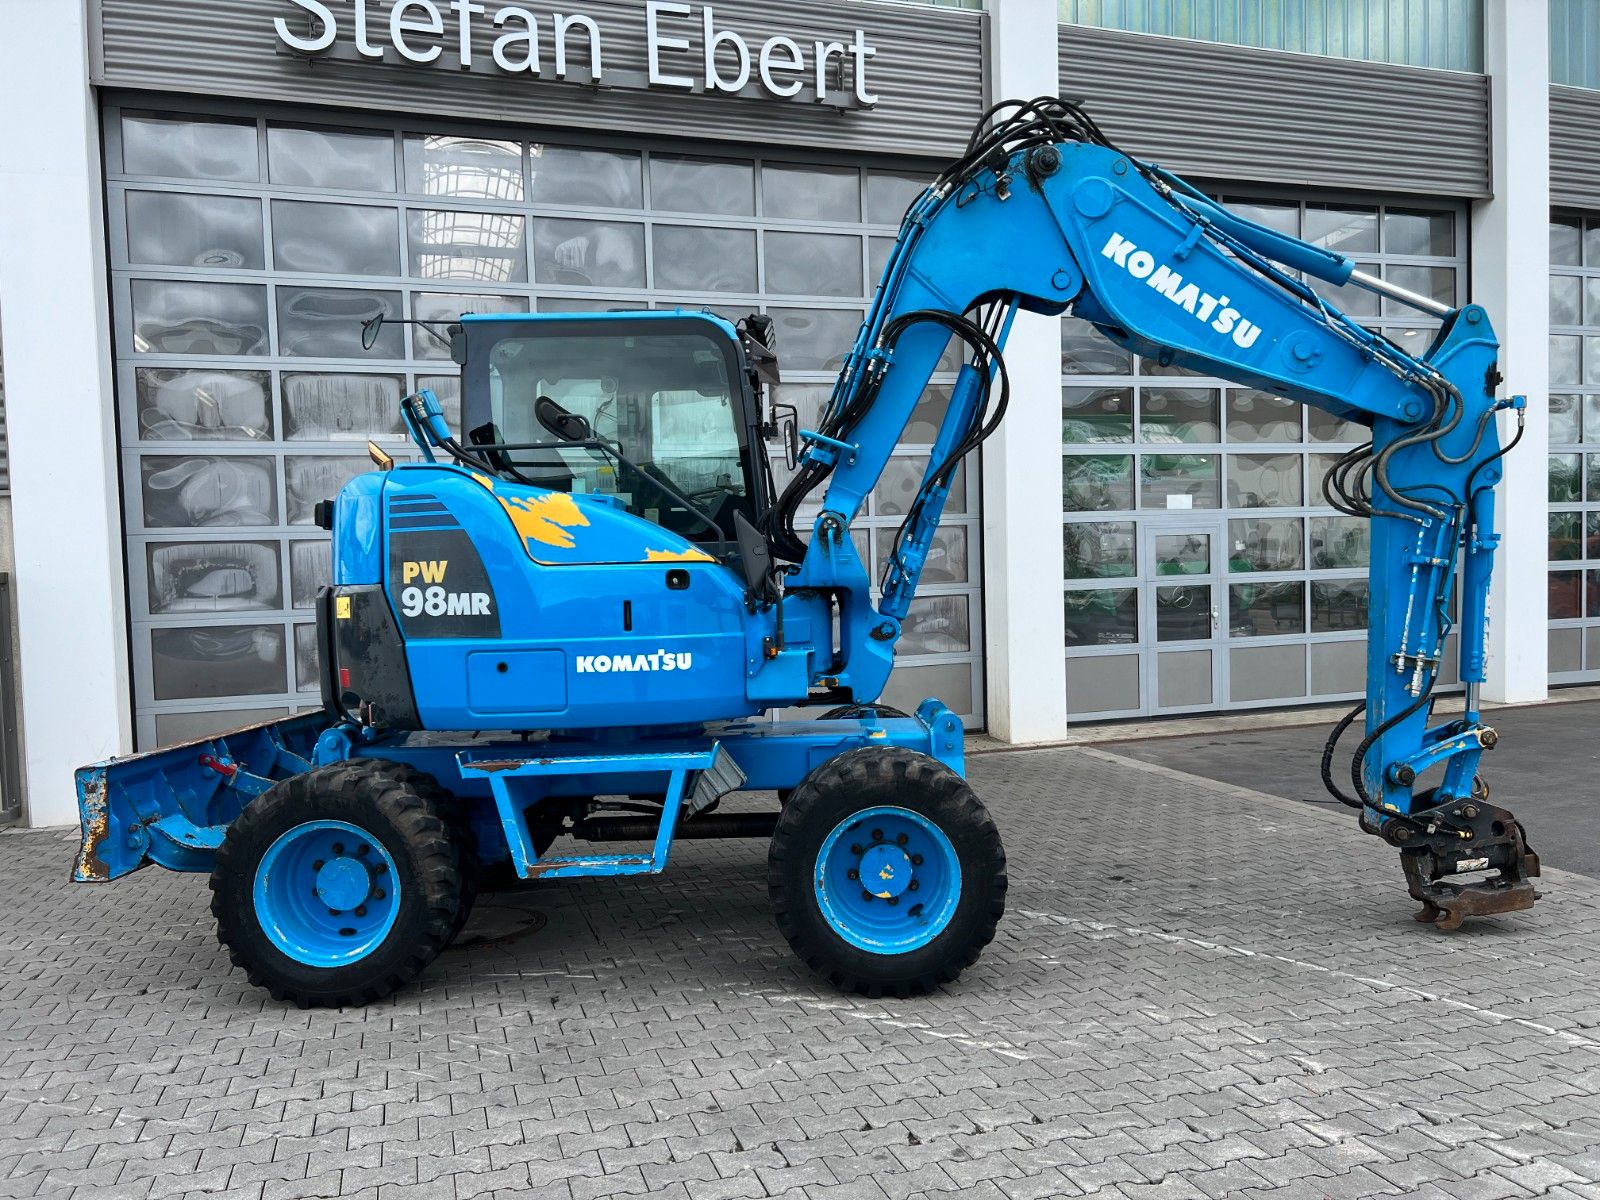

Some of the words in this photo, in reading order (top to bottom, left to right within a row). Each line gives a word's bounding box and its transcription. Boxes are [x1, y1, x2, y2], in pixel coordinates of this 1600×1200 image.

[646, 0, 879, 104] Ebert
[1101, 231, 1263, 348] KOMATSU
[403, 560, 448, 584] PW
[401, 586, 491, 617] 98MR
[576, 649, 691, 673] KOMATSU
